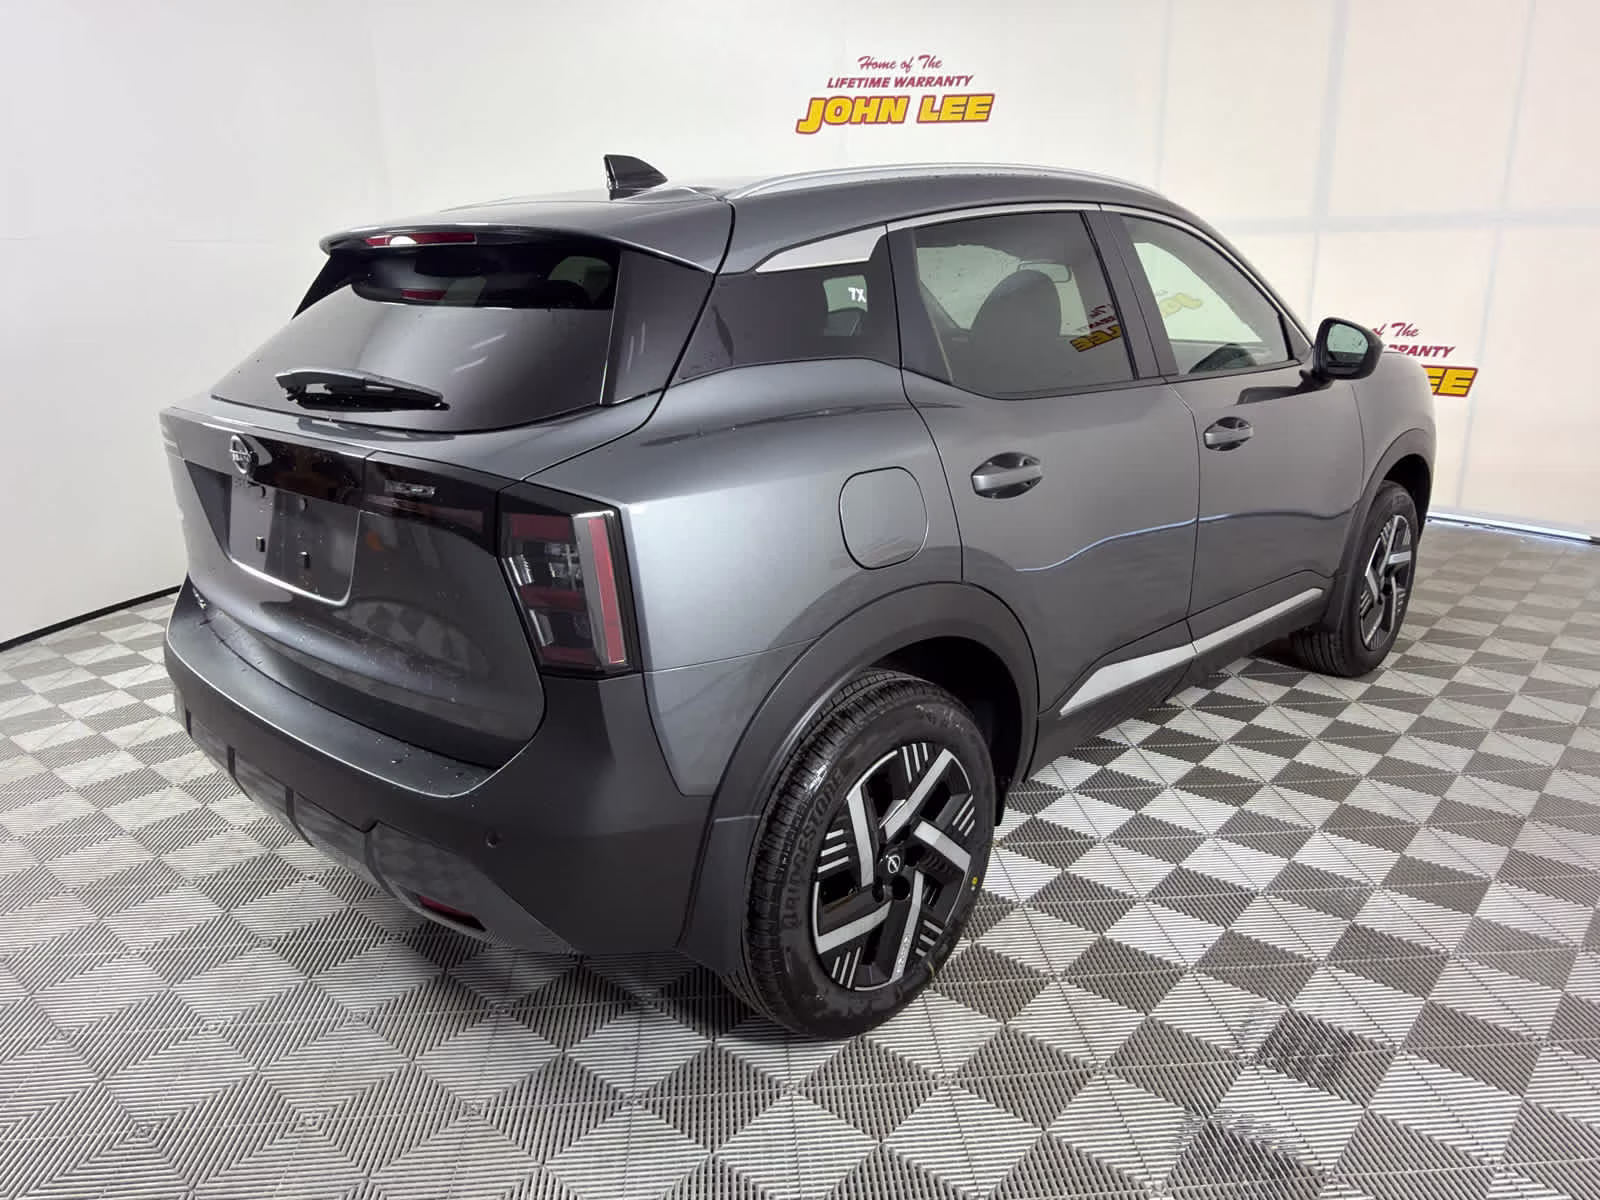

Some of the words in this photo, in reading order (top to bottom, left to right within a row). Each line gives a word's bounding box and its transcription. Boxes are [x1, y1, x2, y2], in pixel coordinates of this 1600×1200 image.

[857, 55, 896, 70] Home
[900, 57, 914, 73] of
[918, 54, 943, 70] The
[826, 77, 891, 89] LIFETIME
[894, 75, 974, 88] WARRANTY
[795, 95, 911, 135] JOHN
[916, 93, 995, 124] LEE
[1391, 322, 1420, 337] The
